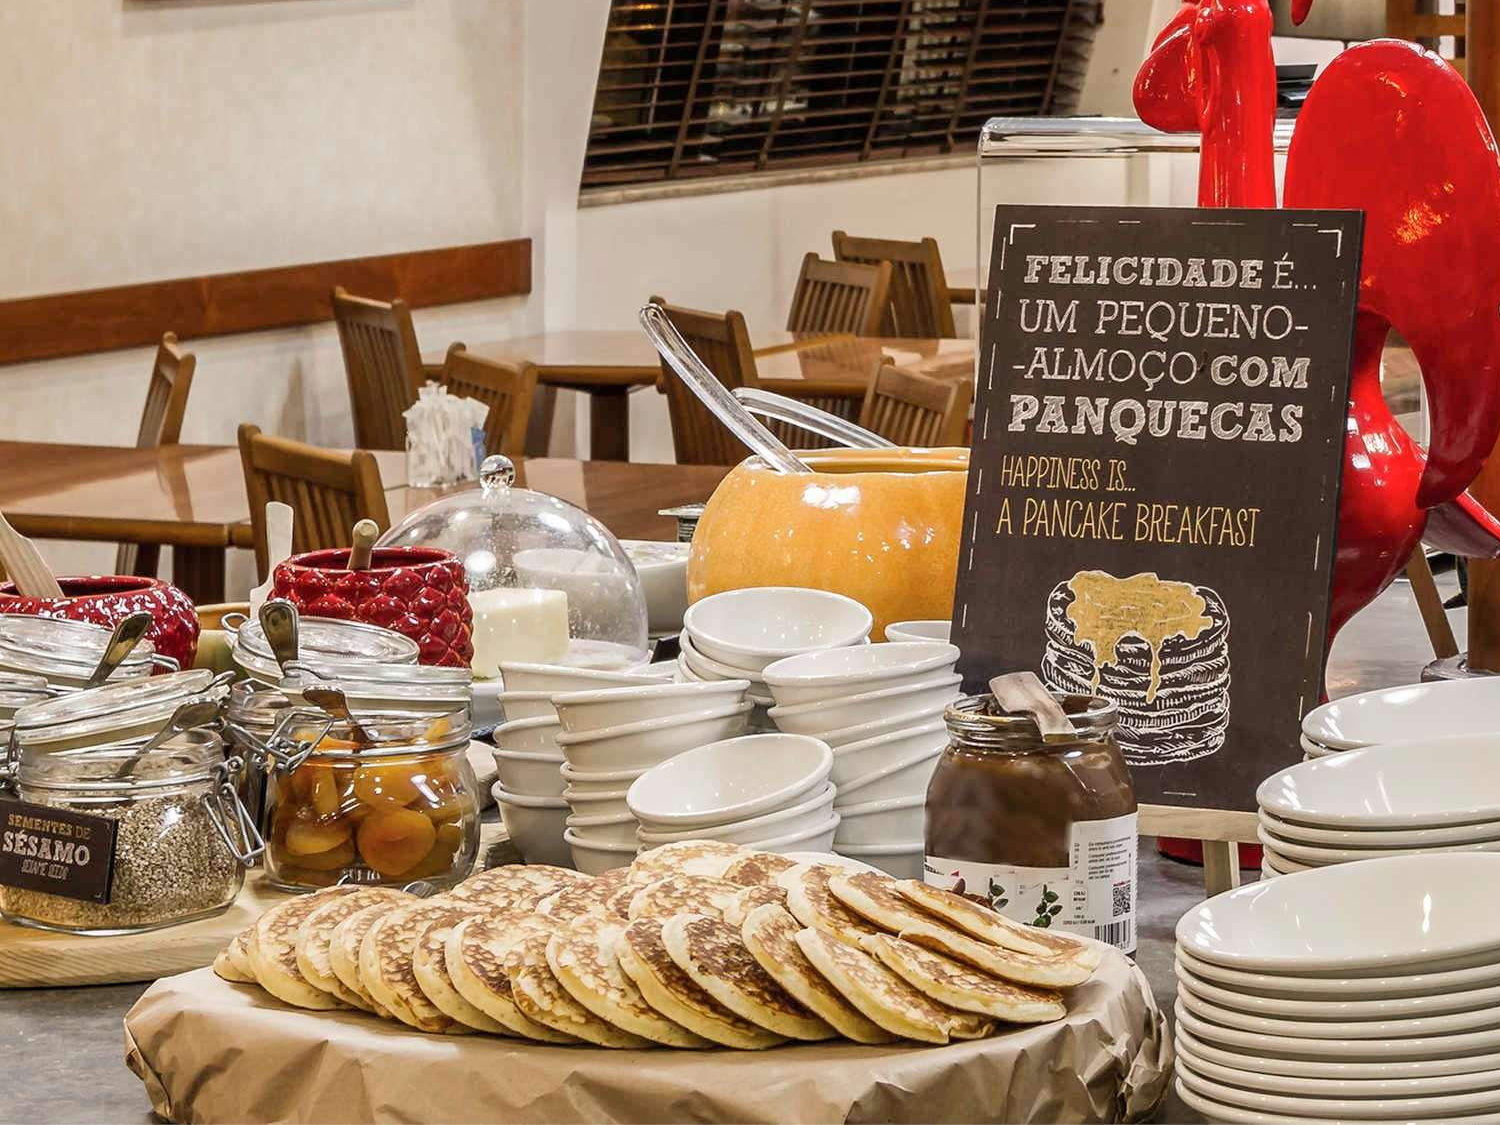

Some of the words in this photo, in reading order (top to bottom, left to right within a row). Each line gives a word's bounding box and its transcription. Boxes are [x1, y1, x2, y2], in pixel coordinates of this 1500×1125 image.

[1023, 254, 1263, 289] FELICIDADE
[1272, 252, 1318, 292] É...
[1019, 299, 1078, 333] UM
[1095, 300, 1309, 342] PEQUENO-
[1013, 346, 1198, 392] -ALMOÇO
[1210, 355, 1311, 390] COM
[1007, 394, 1304, 444] PANQUECAS
[1001, 455, 1100, 492] HAPPINESS
[1107, 458, 1137, 493] IS...
[996, 498, 1014, 535] A
[1023, 498, 1127, 541] PANCAKE
[1134, 503, 1260, 547] BREAKFAST
[8, 814, 72, 837] SEMENTES
[75, 826, 91, 840] DE
[2, 829, 90, 867] SÉSAMO
